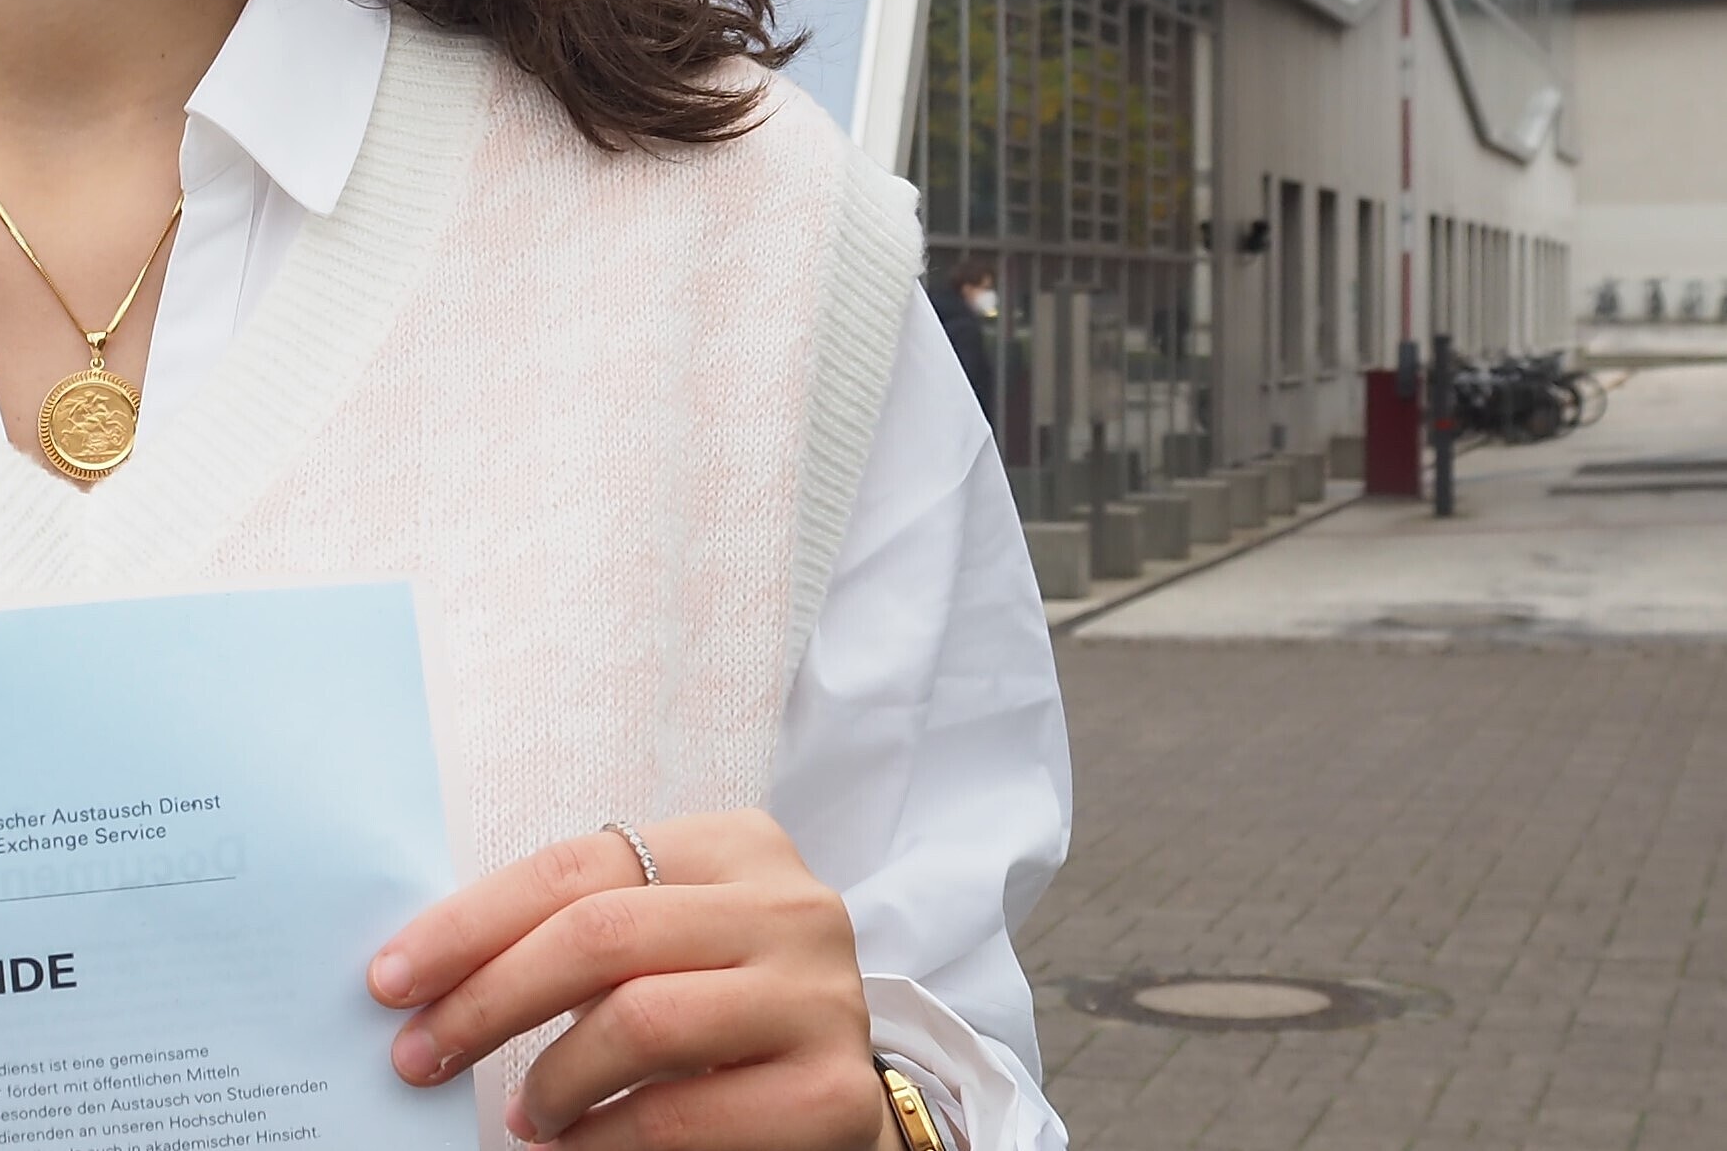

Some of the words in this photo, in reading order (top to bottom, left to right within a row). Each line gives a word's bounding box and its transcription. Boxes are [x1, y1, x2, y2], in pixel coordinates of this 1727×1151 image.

[52, 801, 152, 825] Austausch
[160, 795, 220, 814] Dienst
[95, 824, 166, 844] Service
[50, 1059, 67, 1072] ist
[73, 1058, 104, 1070] eine
[110, 1047, 208, 1070] gemeinsame
[64, 1081, 88, 1093] mit
[93, 1073, 181, 1091] öffentlichen
[187, 1065, 239, 1081] Mitteln
[77, 1101, 105, 1114] den
[111, 1092, 189, 1112] Austausch
[194, 1092, 221, 1104] von
[227, 1079, 328, 1101] Studierenden
[79, 1126, 96, 1137] an
[102, 1121, 164, 1135] unseren
[170, 1109, 266, 1129] Hochschulen
[146, 1133, 250, 1151] akademischer
[256, 1126, 321, 1144] Hinsicht.
